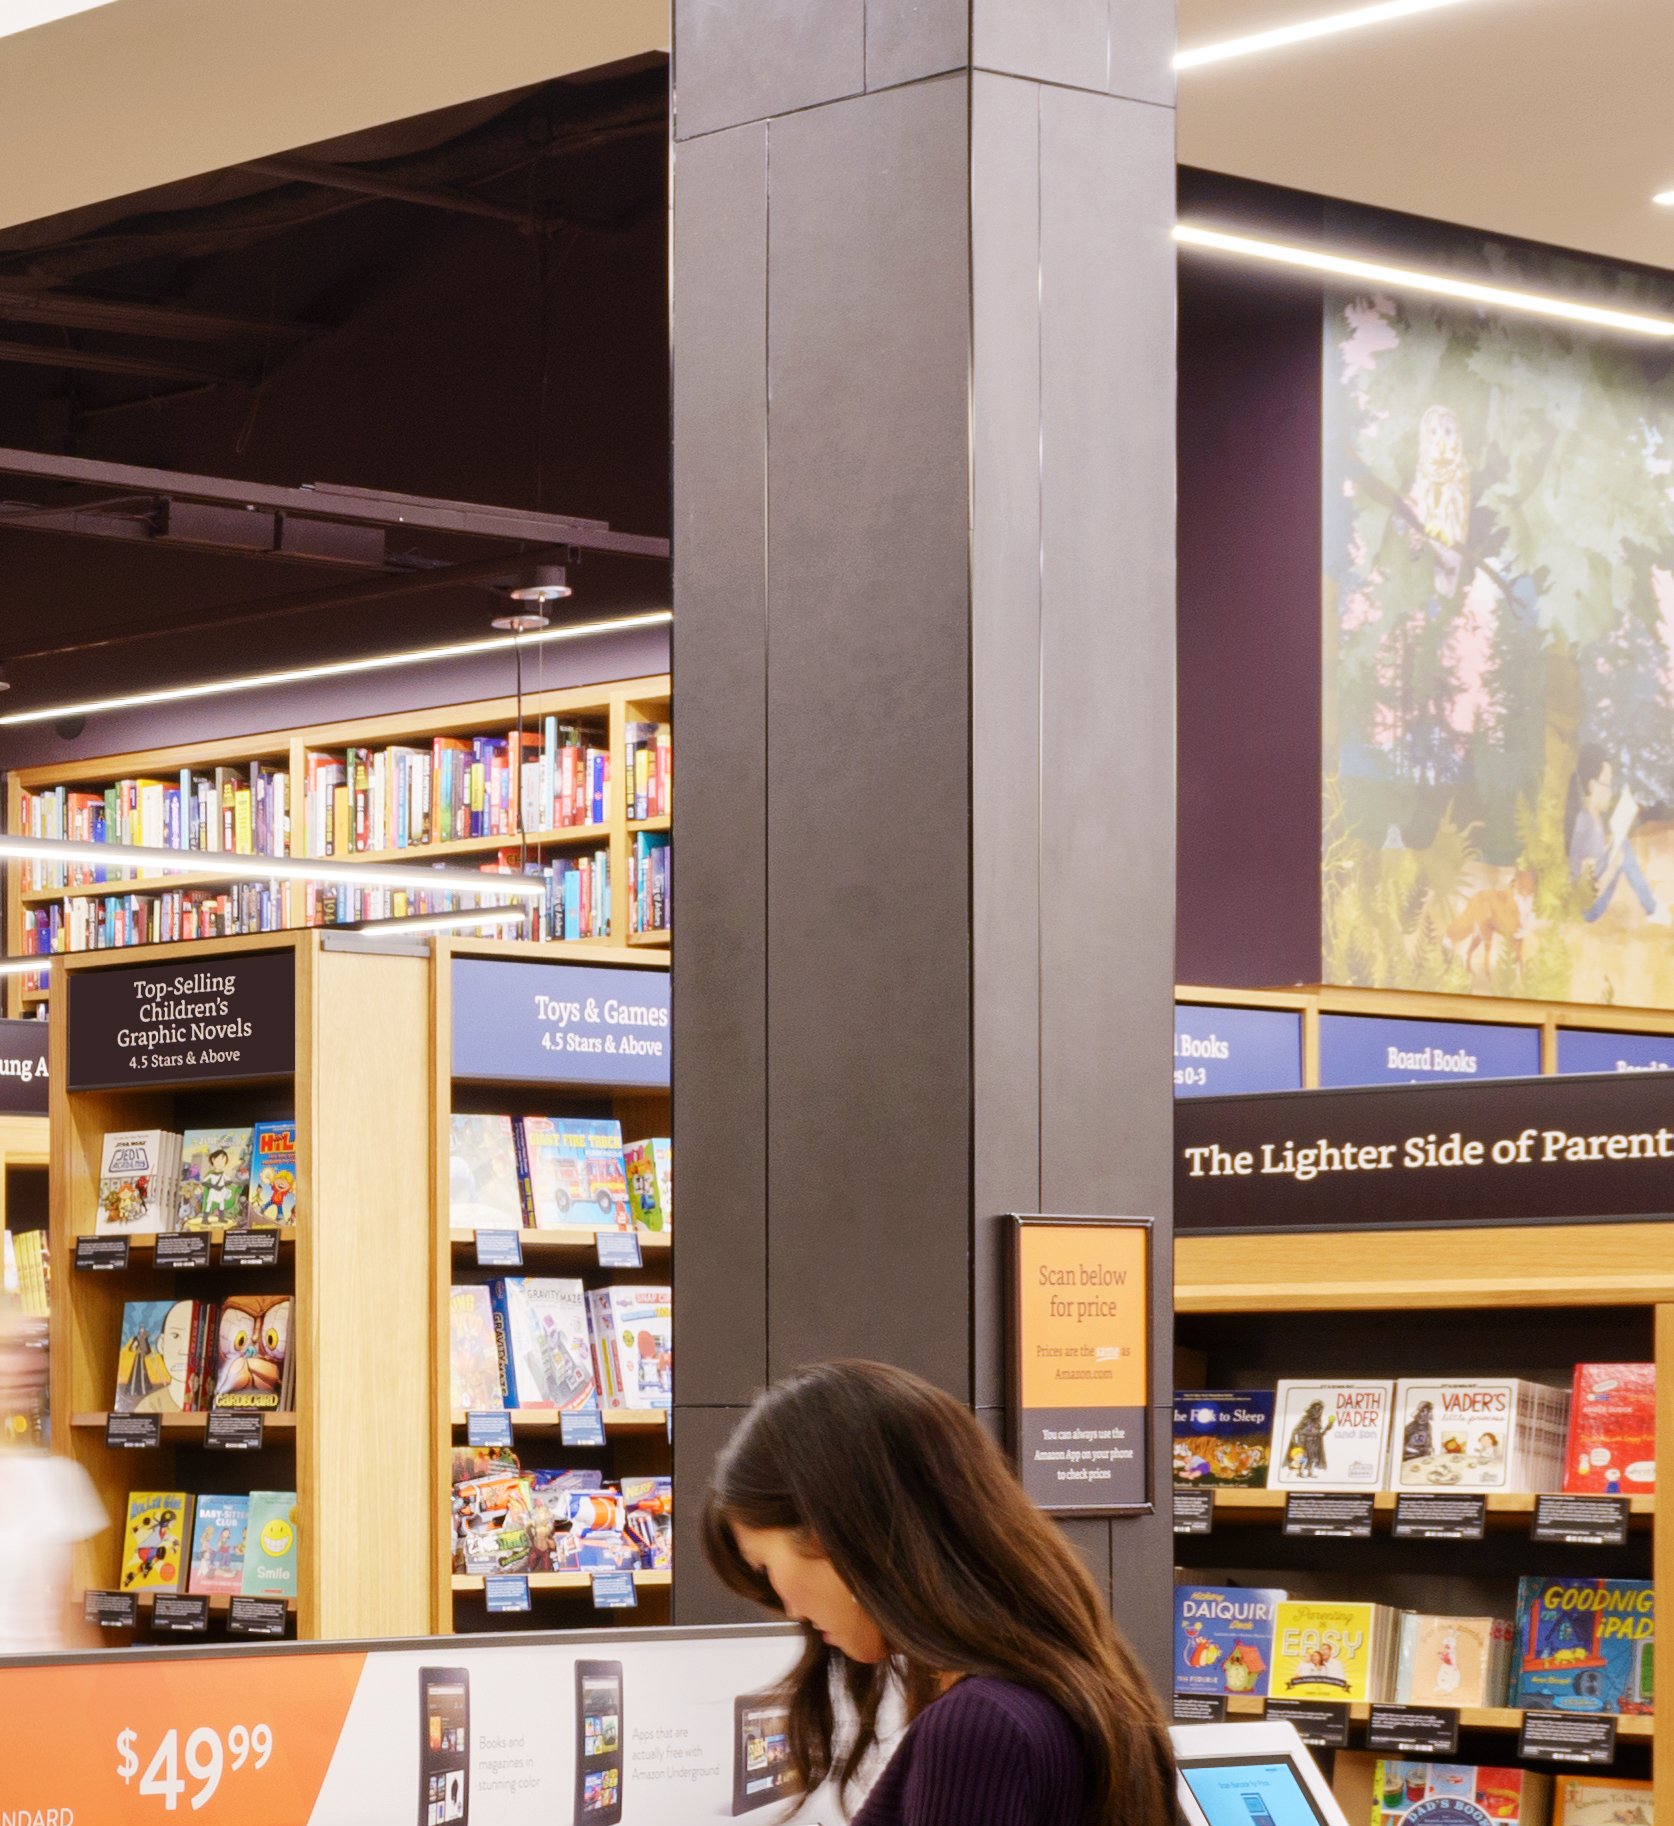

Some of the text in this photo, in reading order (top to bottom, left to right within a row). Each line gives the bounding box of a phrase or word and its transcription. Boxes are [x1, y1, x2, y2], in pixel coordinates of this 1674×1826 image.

[134, 972, 236, 996] Top-Selling
[139, 998, 228, 1022] Children's
[535, 996, 668, 1027] Toys & Games
[117, 1019, 252, 1049] Graphic Novels
[542, 1032, 661, 1055] 4.5 Stars & Above
[1181, 1035, 1229, 1059] Books
[129, 1047, 240, 1069] 4.5 Stars & Above
[1388, 1047, 1477, 1072] Board Books
[1185, 1146, 1253, 1178] The
[1261, 1140, 1396, 1181] Lighter
[1403, 1135, 1483, 1169] Side
[1492, 1130, 1536, 1164] of
[1039, 1264, 1127, 1286] Scan below
[1050, 1295, 1117, 1322] for price
[1037, 1345, 1061, 1357] Prices
[1065, 1348, 1078, 1357] are
[1080, 1346, 1095, 1357] the
[1121, 1349, 1130, 1357] as
[1054, 1369, 1113, 1380] Amazon.com
[216, 1394, 278, 1407] CARDBOARD
[1336, 1393, 1380, 1411] DARTH
[1442, 1392, 1506, 1413] VADER'S
[1219, 1408, 1265, 1424] to Sleep
[1336, 1410, 1377, 1428] VADER
[256, 1565, 291, 1581] Smile
[1282, 1629, 1362, 1657] EASY
[479, 1736, 524, 1749] Books and
[632, 1728, 688, 1742] Apps that are
[632, 1745, 703, 1762] actually free with
[479, 1759, 533, 1773] magazines in
[632, 1765, 720, 1781] Amazon Underground
[479, 1778, 540, 1792] stunning color
